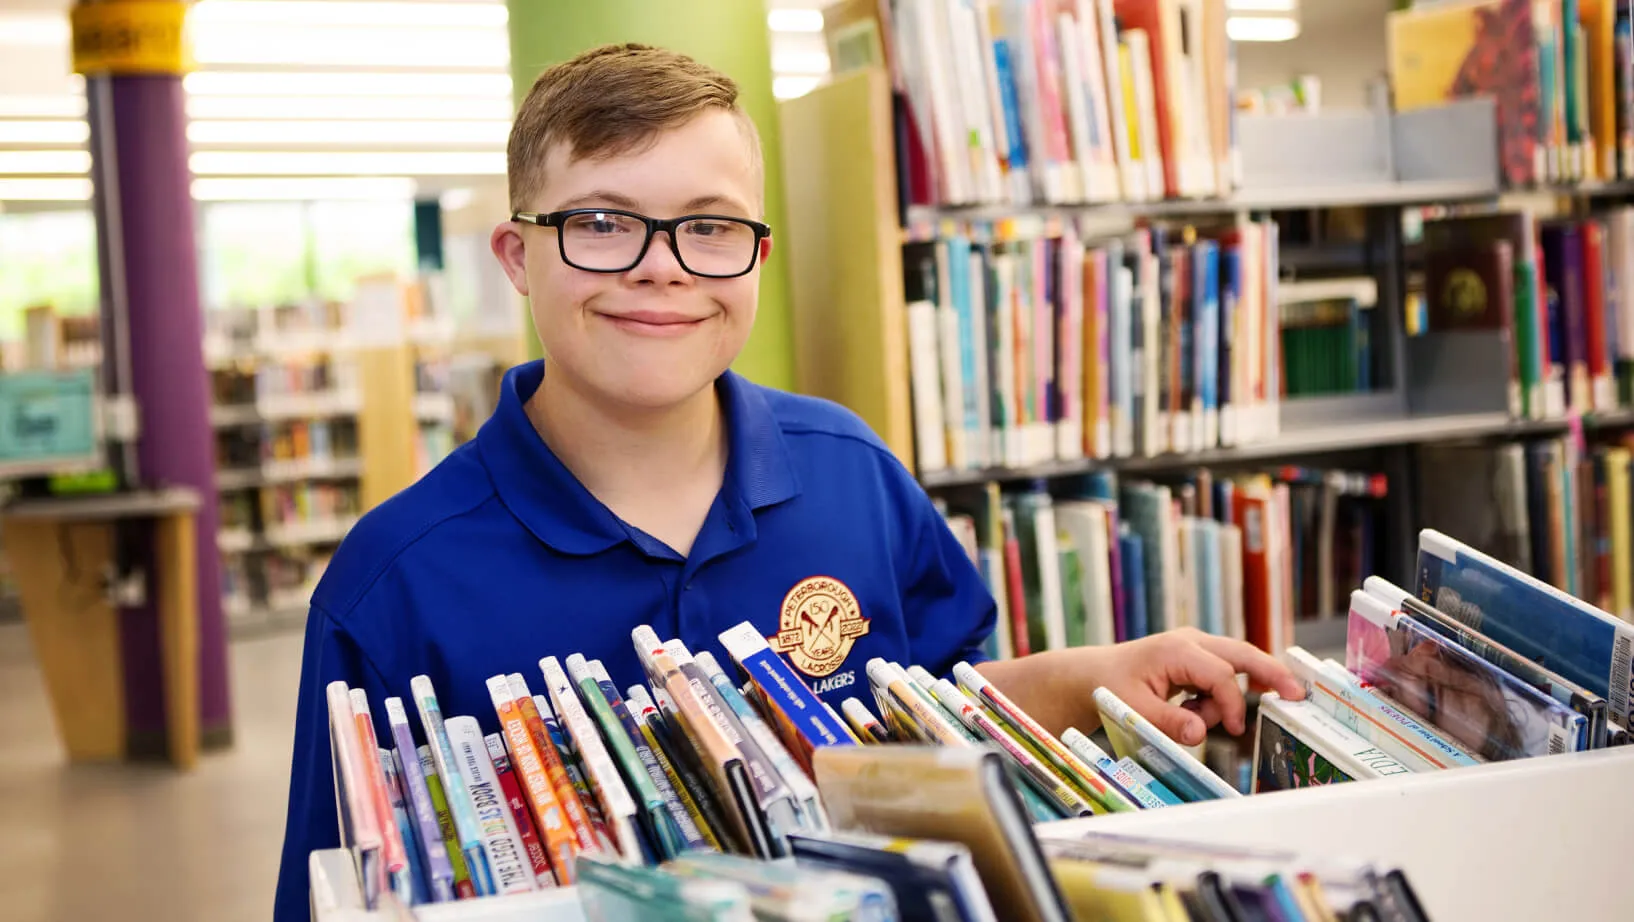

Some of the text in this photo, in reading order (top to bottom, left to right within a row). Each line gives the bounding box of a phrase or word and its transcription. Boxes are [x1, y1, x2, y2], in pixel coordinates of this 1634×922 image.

[786, 582, 852, 616] PETERBOROUGH
[811, 600, 829, 615] 150
[842, 621, 863, 633] 2022
[781, 632, 800, 644] 1872
[813, 647, 835, 658] YEARS
[813, 670, 855, 694] LAKERS
[1379, 705, 1409, 724] POEMS
[1430, 737, 1453, 753] School
[469, 781, 497, 808] BOOK
[479, 808, 507, 836] IDEAS
[489, 837, 517, 863] LEGO
[498, 865, 525, 886] THE
